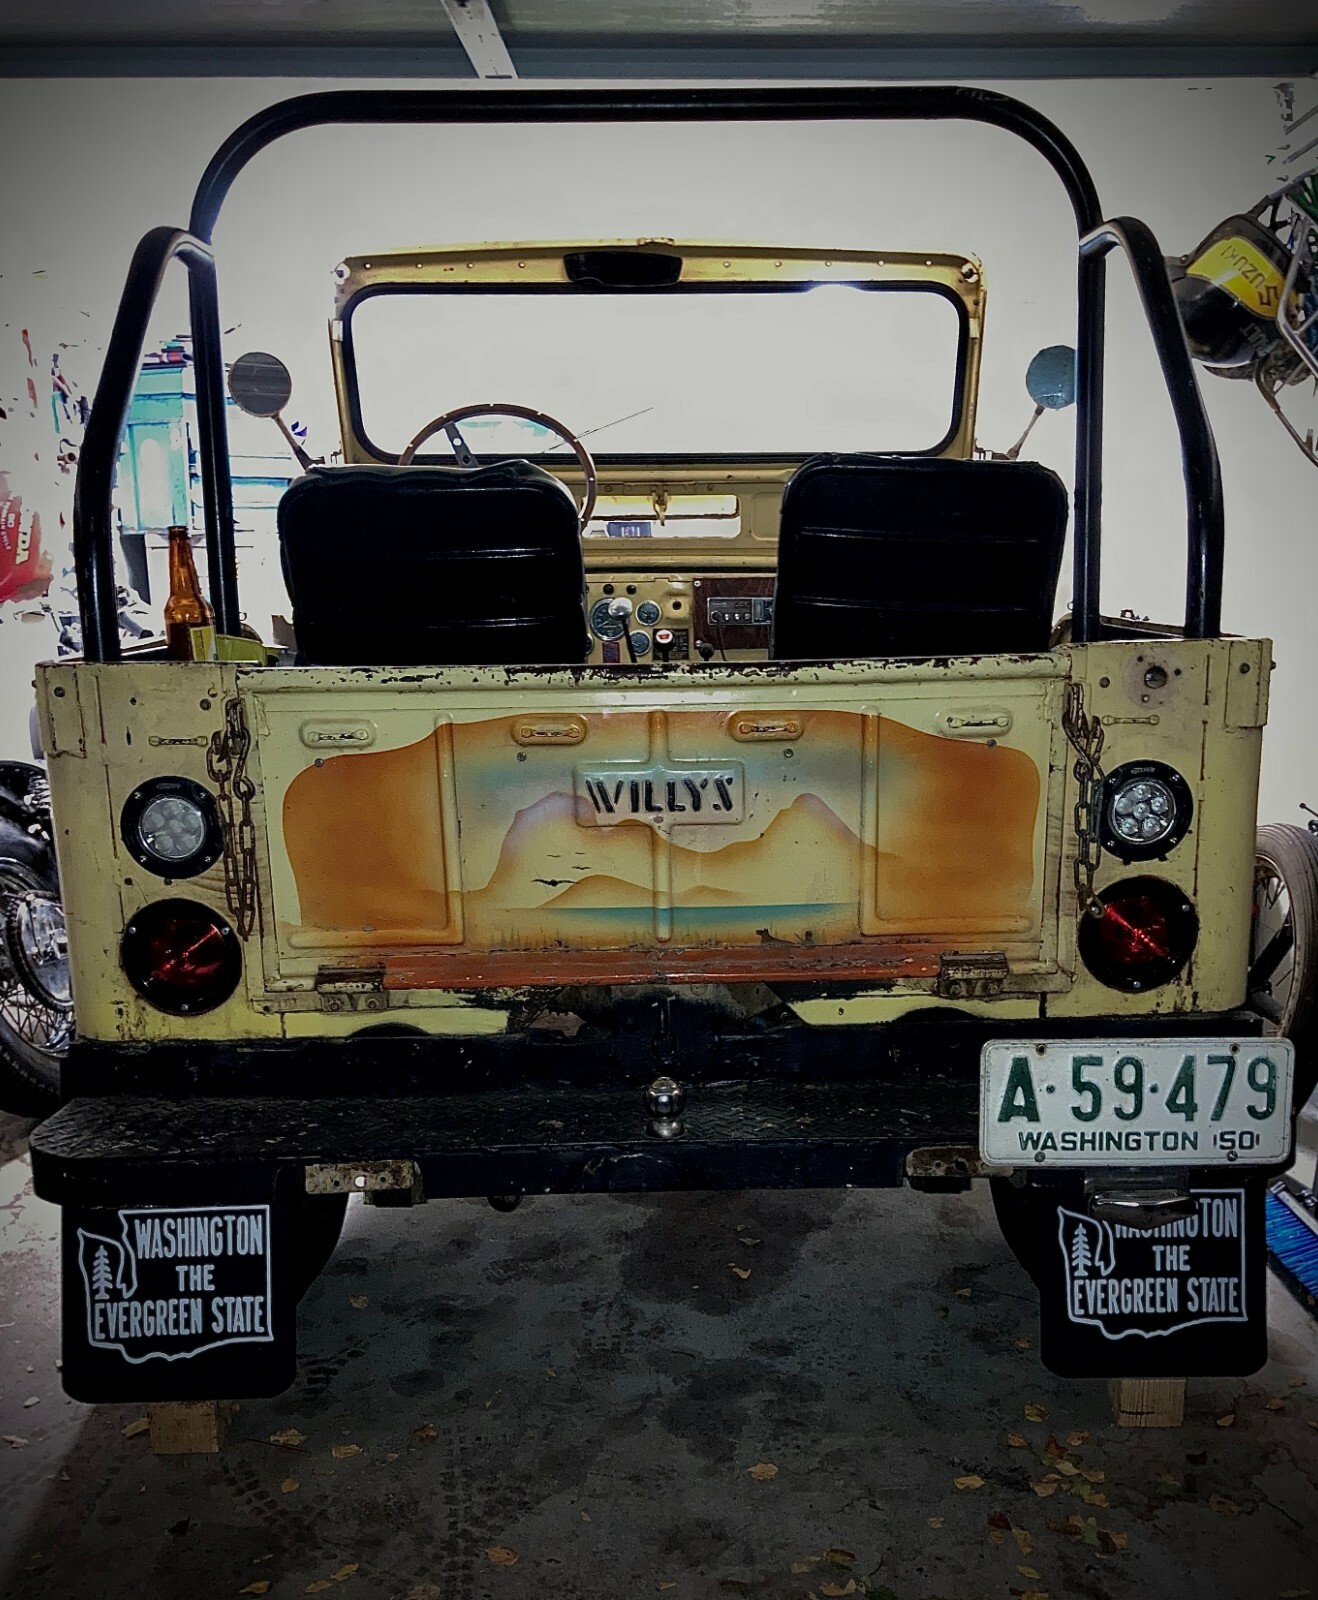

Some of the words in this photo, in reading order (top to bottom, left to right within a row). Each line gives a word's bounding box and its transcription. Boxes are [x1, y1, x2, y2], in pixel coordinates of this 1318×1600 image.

[1220, 245, 1279, 306] SUZUKI
[585, 776, 734, 813] WILLYS
[1018, 1131, 1198, 1151] WASHINGTON
[134, 1214, 263, 1259] WASHINGTON
[1152, 1244, 1191, 1271] THE
[175, 1264, 215, 1292] THE
[1073, 1277, 1178, 1315] EVERGREEN
[1187, 1276, 1239, 1313] STATE
[94, 1298, 203, 1340] EVERGREEN
[211, 1296, 265, 1334] STATE
